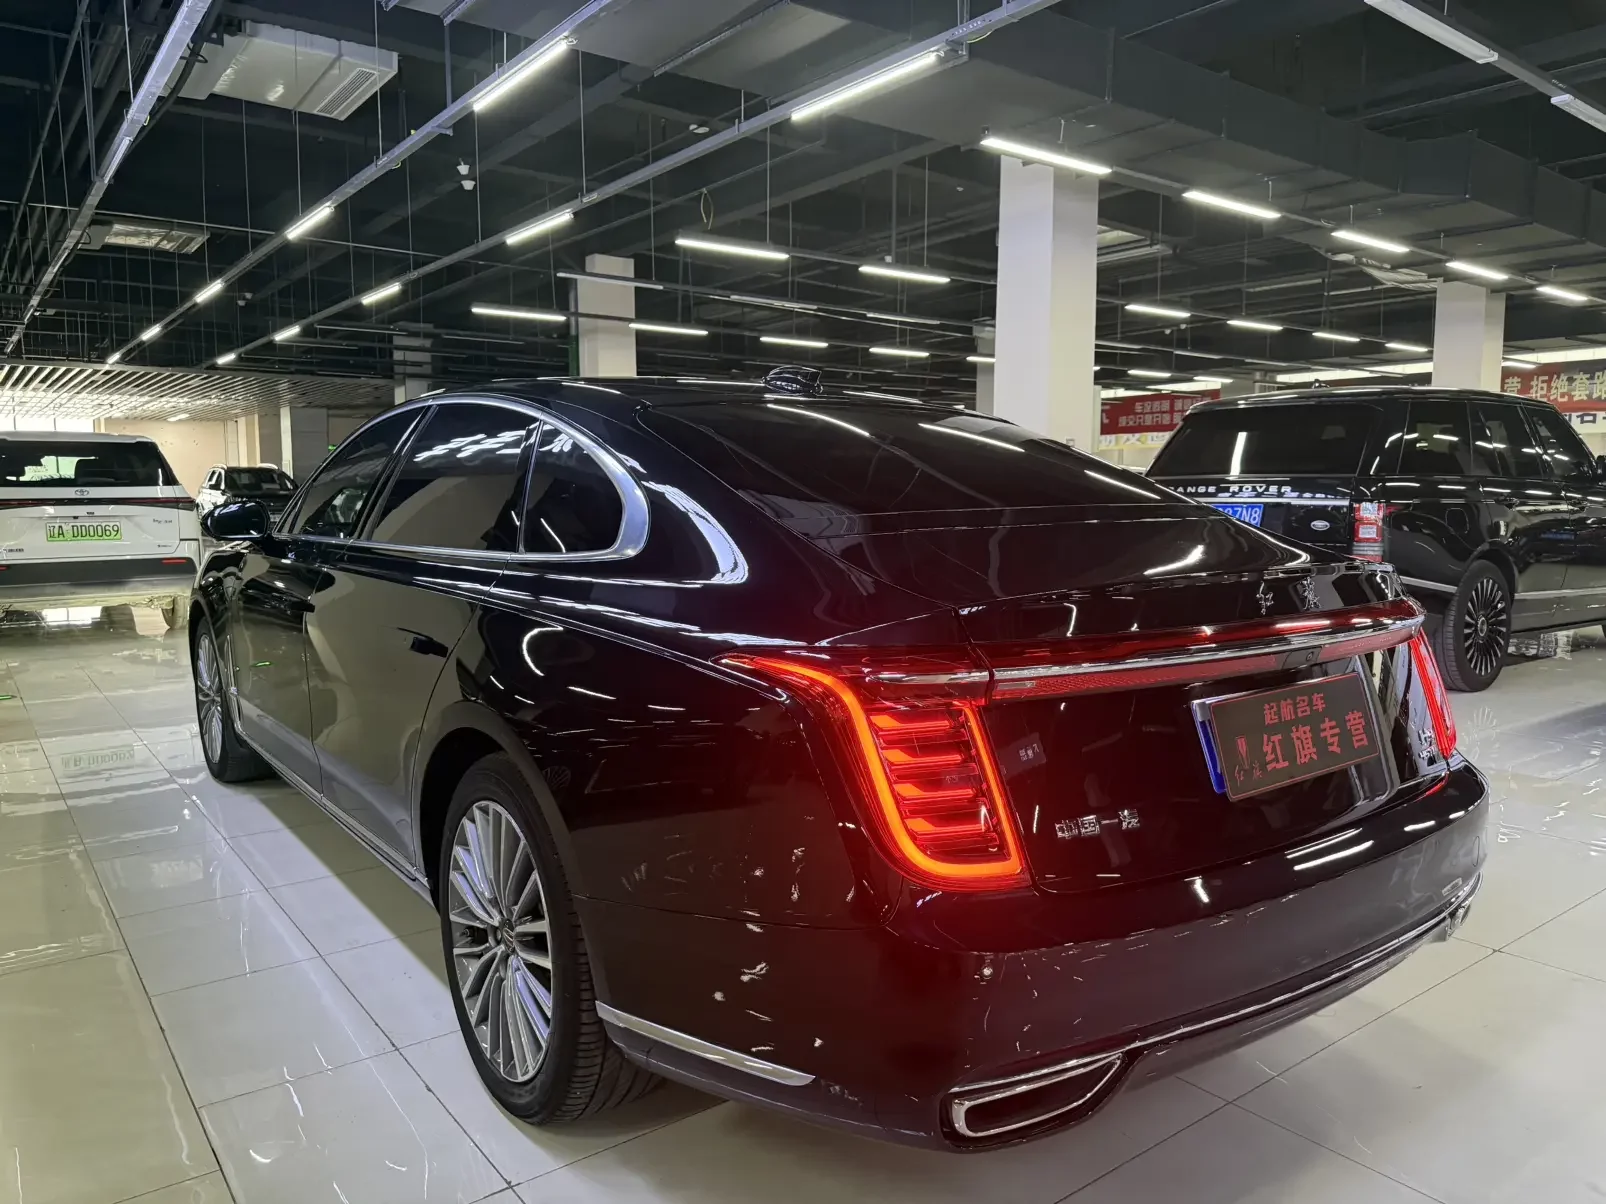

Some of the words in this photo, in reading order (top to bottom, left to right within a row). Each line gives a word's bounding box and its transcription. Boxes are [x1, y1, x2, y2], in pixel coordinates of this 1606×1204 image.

[1229, 485, 1292, 493] ROVER
[1217, 507, 1260, 524] 7N8
[48, 525, 65, 539] 辽A
[72, 525, 120, 539] DD0069
[1264, 692, 1326, 725] 起航名车
[1263, 711, 1369, 772] 红旗专营
